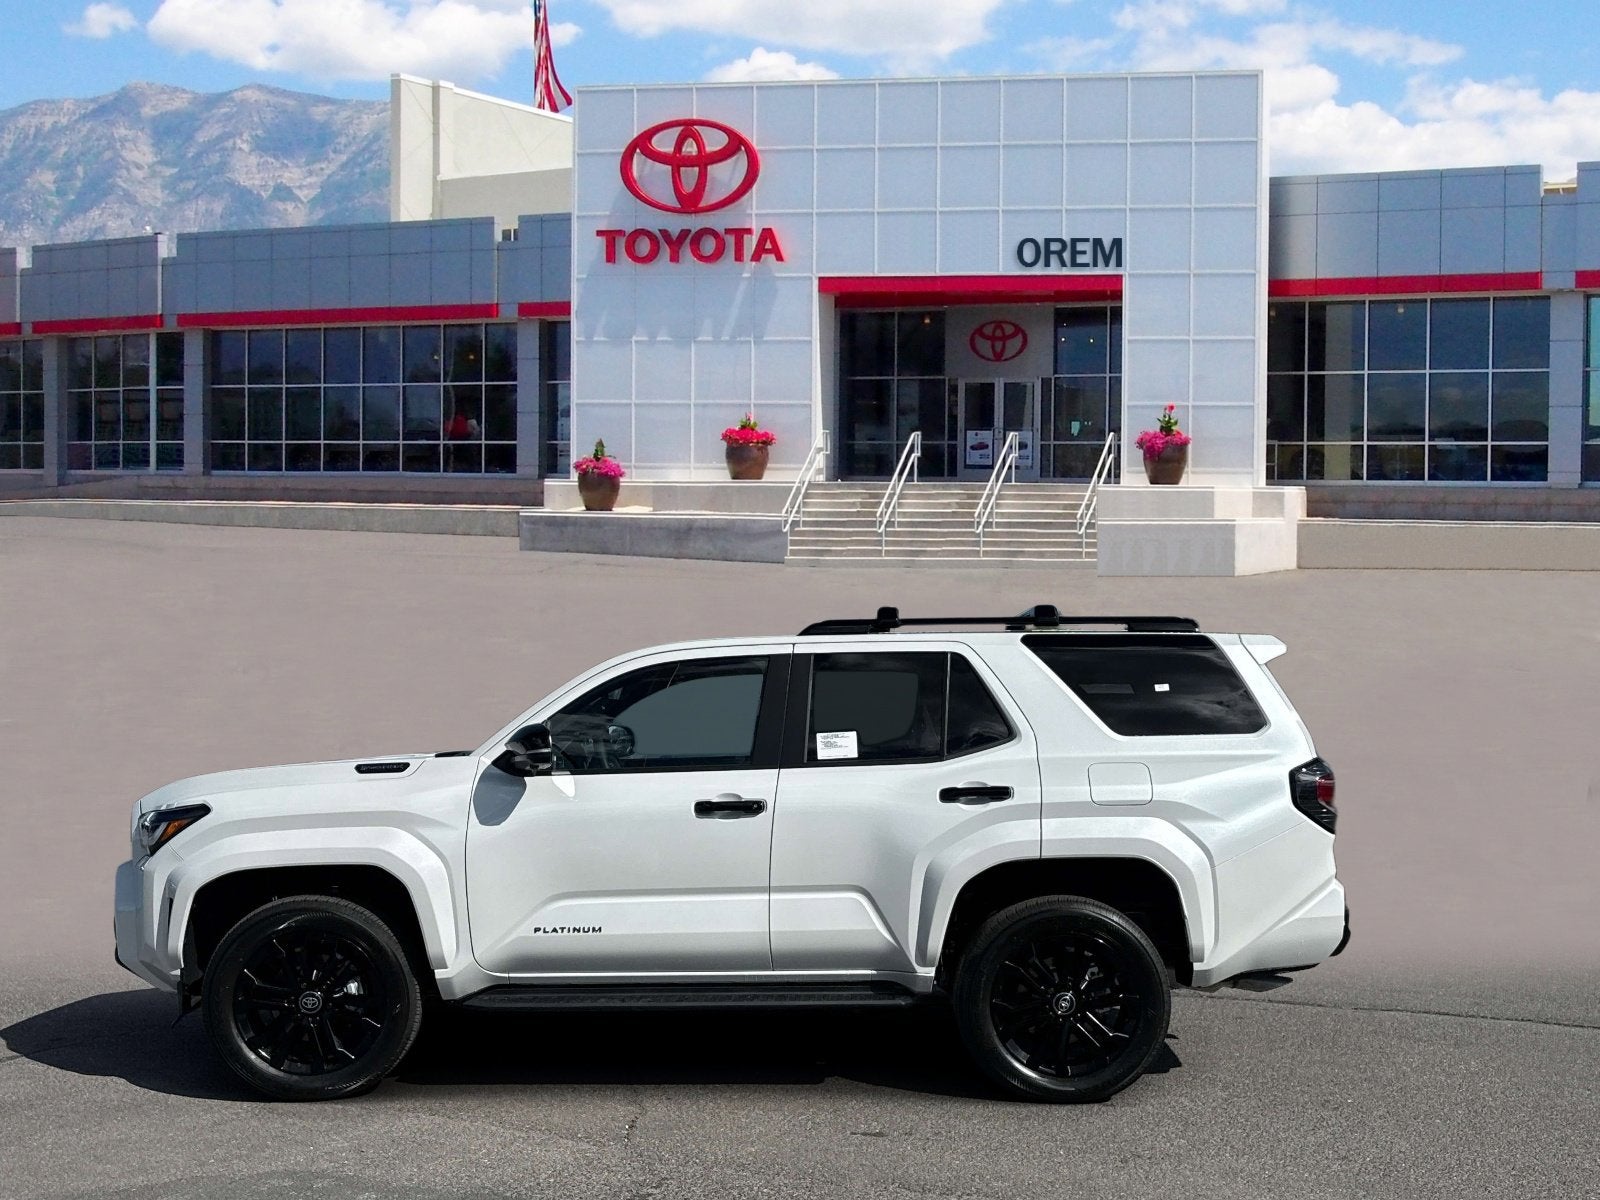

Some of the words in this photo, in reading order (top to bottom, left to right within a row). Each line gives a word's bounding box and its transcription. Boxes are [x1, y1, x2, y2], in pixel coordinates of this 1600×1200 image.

[596, 227, 785, 264] TOYOTA
[1017, 237, 1123, 268] OREM
[533, 926, 603, 934] PLATINUM
